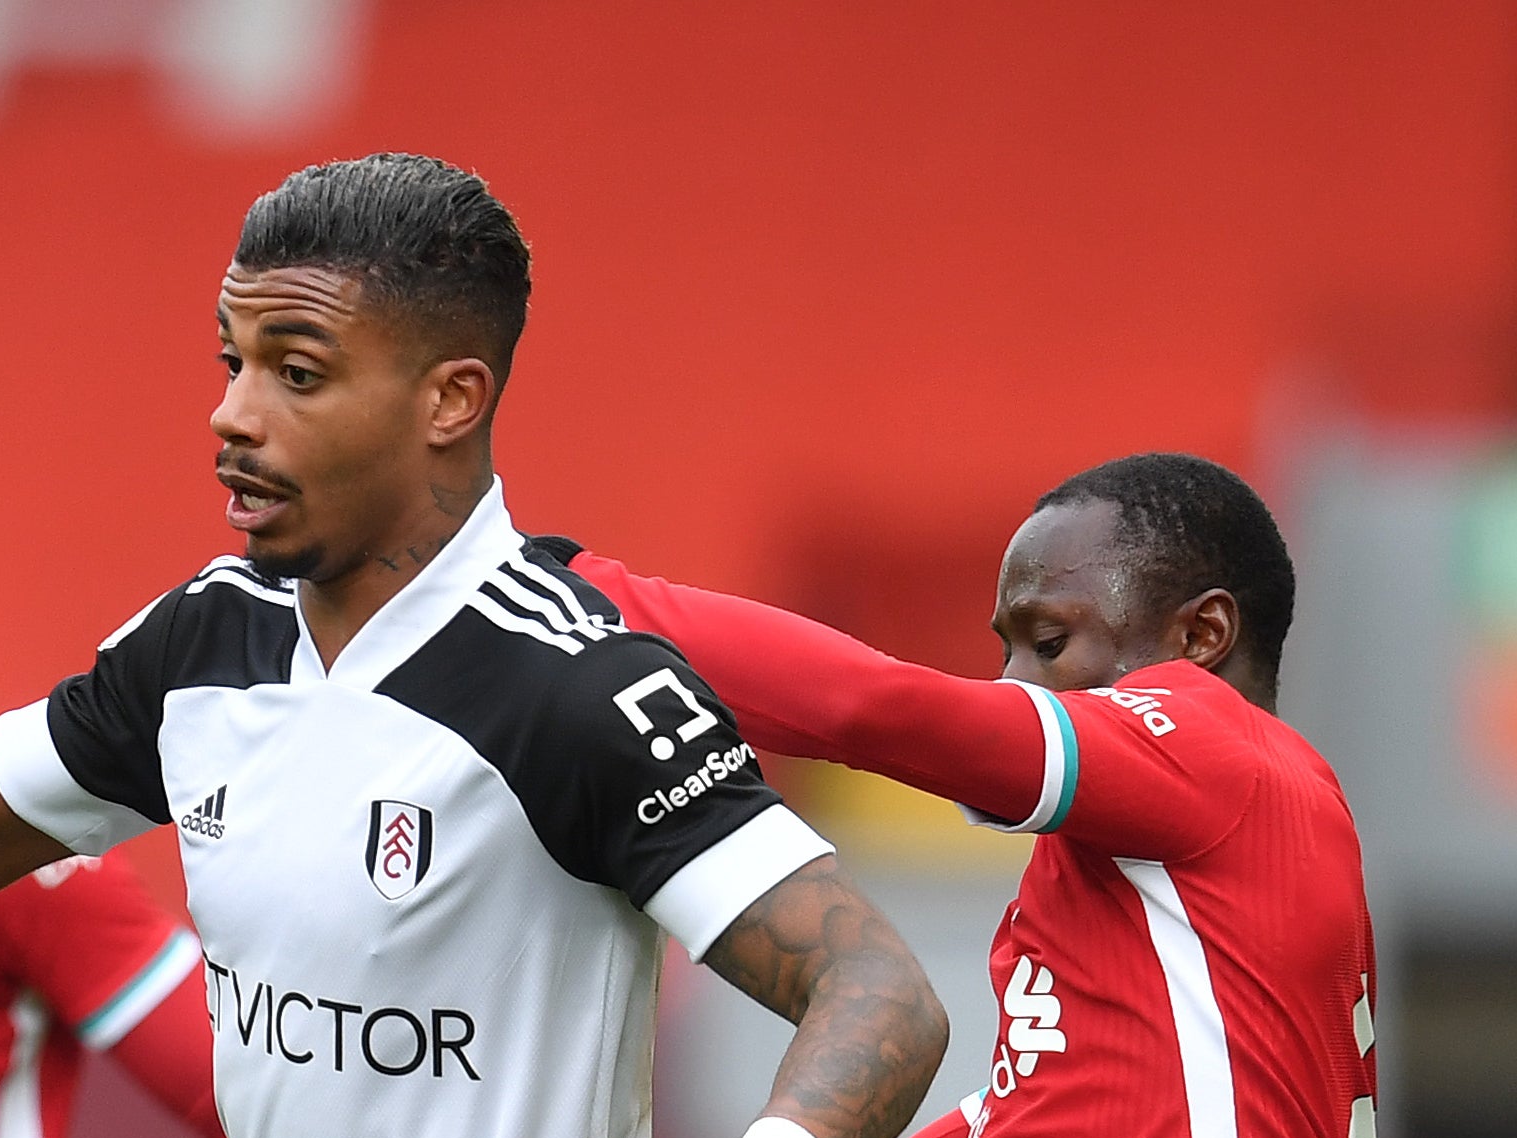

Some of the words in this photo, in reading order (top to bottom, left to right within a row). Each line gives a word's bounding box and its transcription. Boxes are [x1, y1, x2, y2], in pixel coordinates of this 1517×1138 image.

[181, 814, 225, 839] adidas
[382, 811, 415, 879] FFC
[201, 952, 482, 1081] TVICTOR
